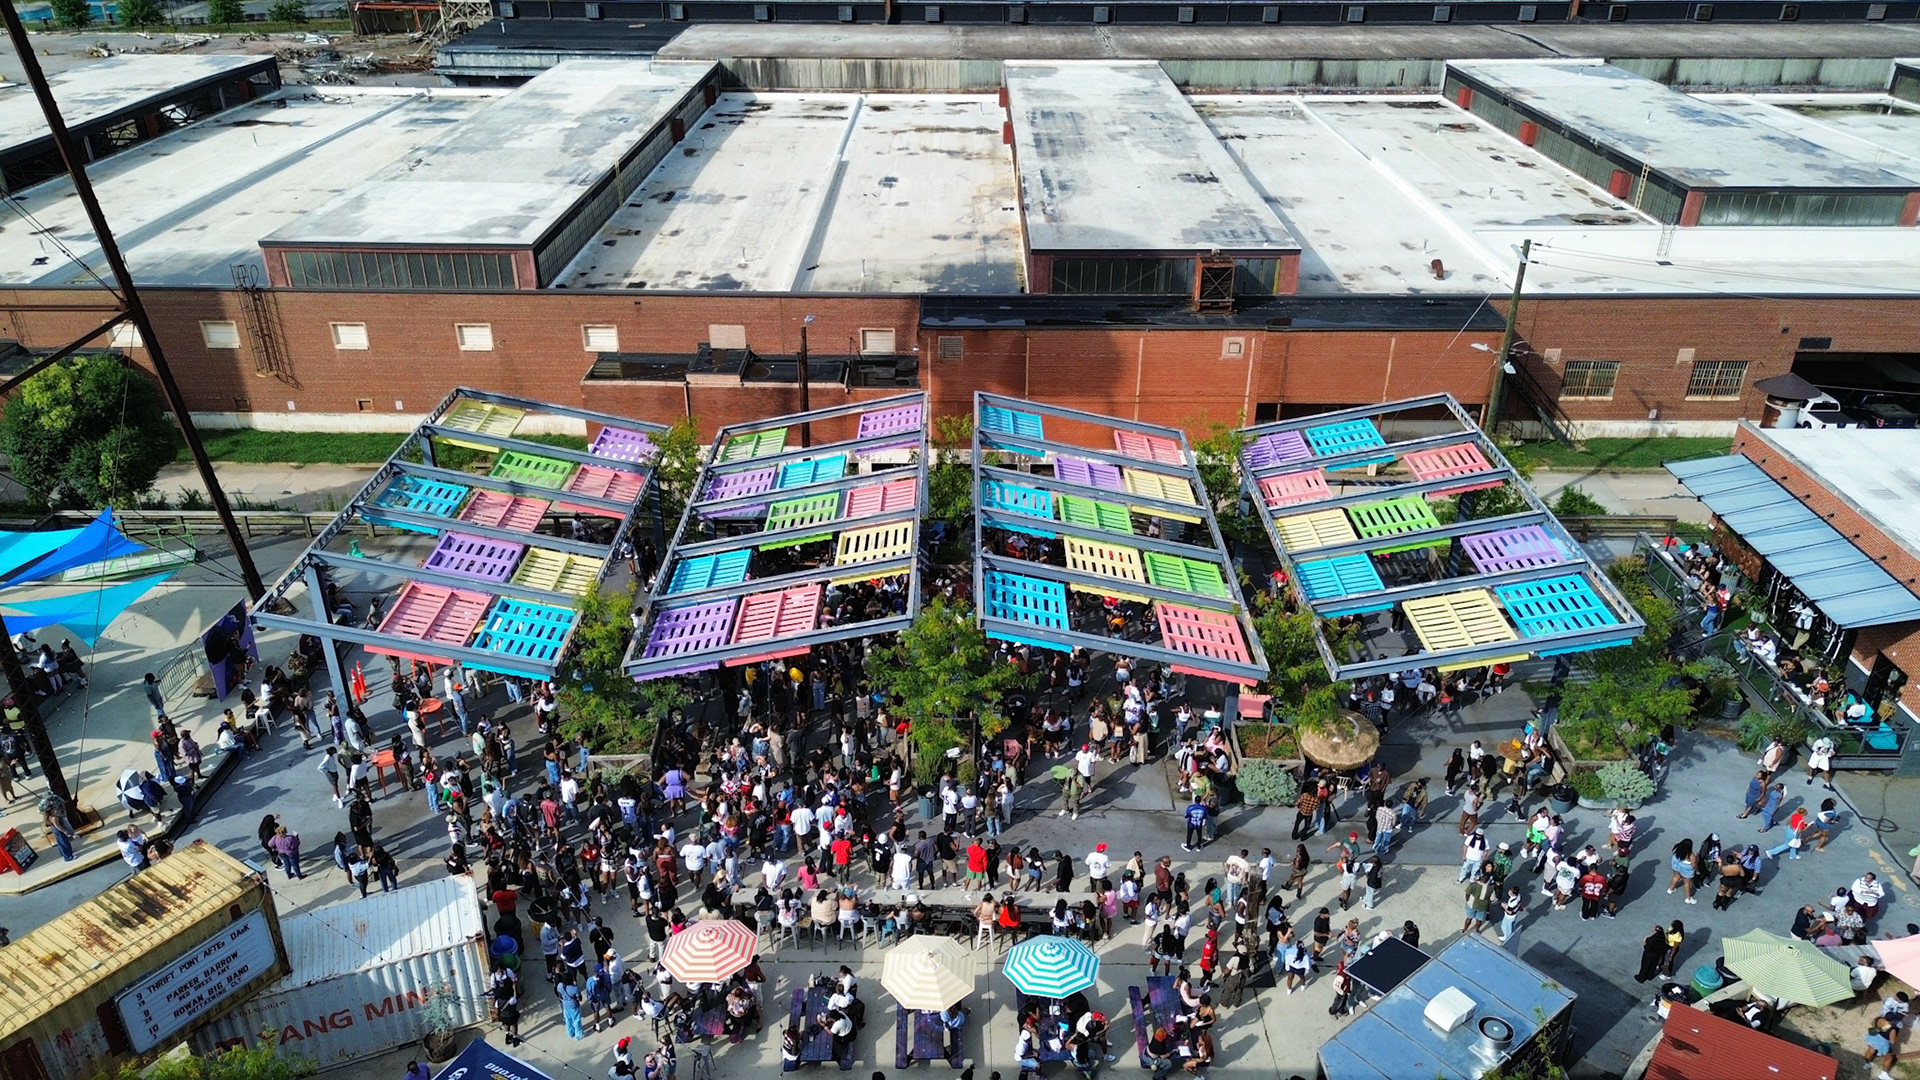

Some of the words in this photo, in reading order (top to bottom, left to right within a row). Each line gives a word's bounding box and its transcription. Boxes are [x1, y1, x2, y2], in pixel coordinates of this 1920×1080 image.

[1584, 882, 1603, 896] 22
[136, 993, 143, 1001] 9
[146, 971, 175, 994] THRIFT
[179, 956, 200, 973] PONY
[203, 940, 225, 959] AFTER
[230, 923, 250, 941] DARK
[166, 976, 200, 1002] PARKER
[203, 951, 239, 978] BARROW
[149, 1024, 159, 1035] 10
[173, 994, 204, 1019] ROWAN
[208, 981, 223, 996] BIG
[227, 964, 249, 984] BAND
[178, 991, 191, 1002] RED
[194, 977, 213, 992] DRESS
[217, 966, 231, 977] AMY
[230, 977, 242, 988] CLT
[483, 1062, 528, 1080] orona
